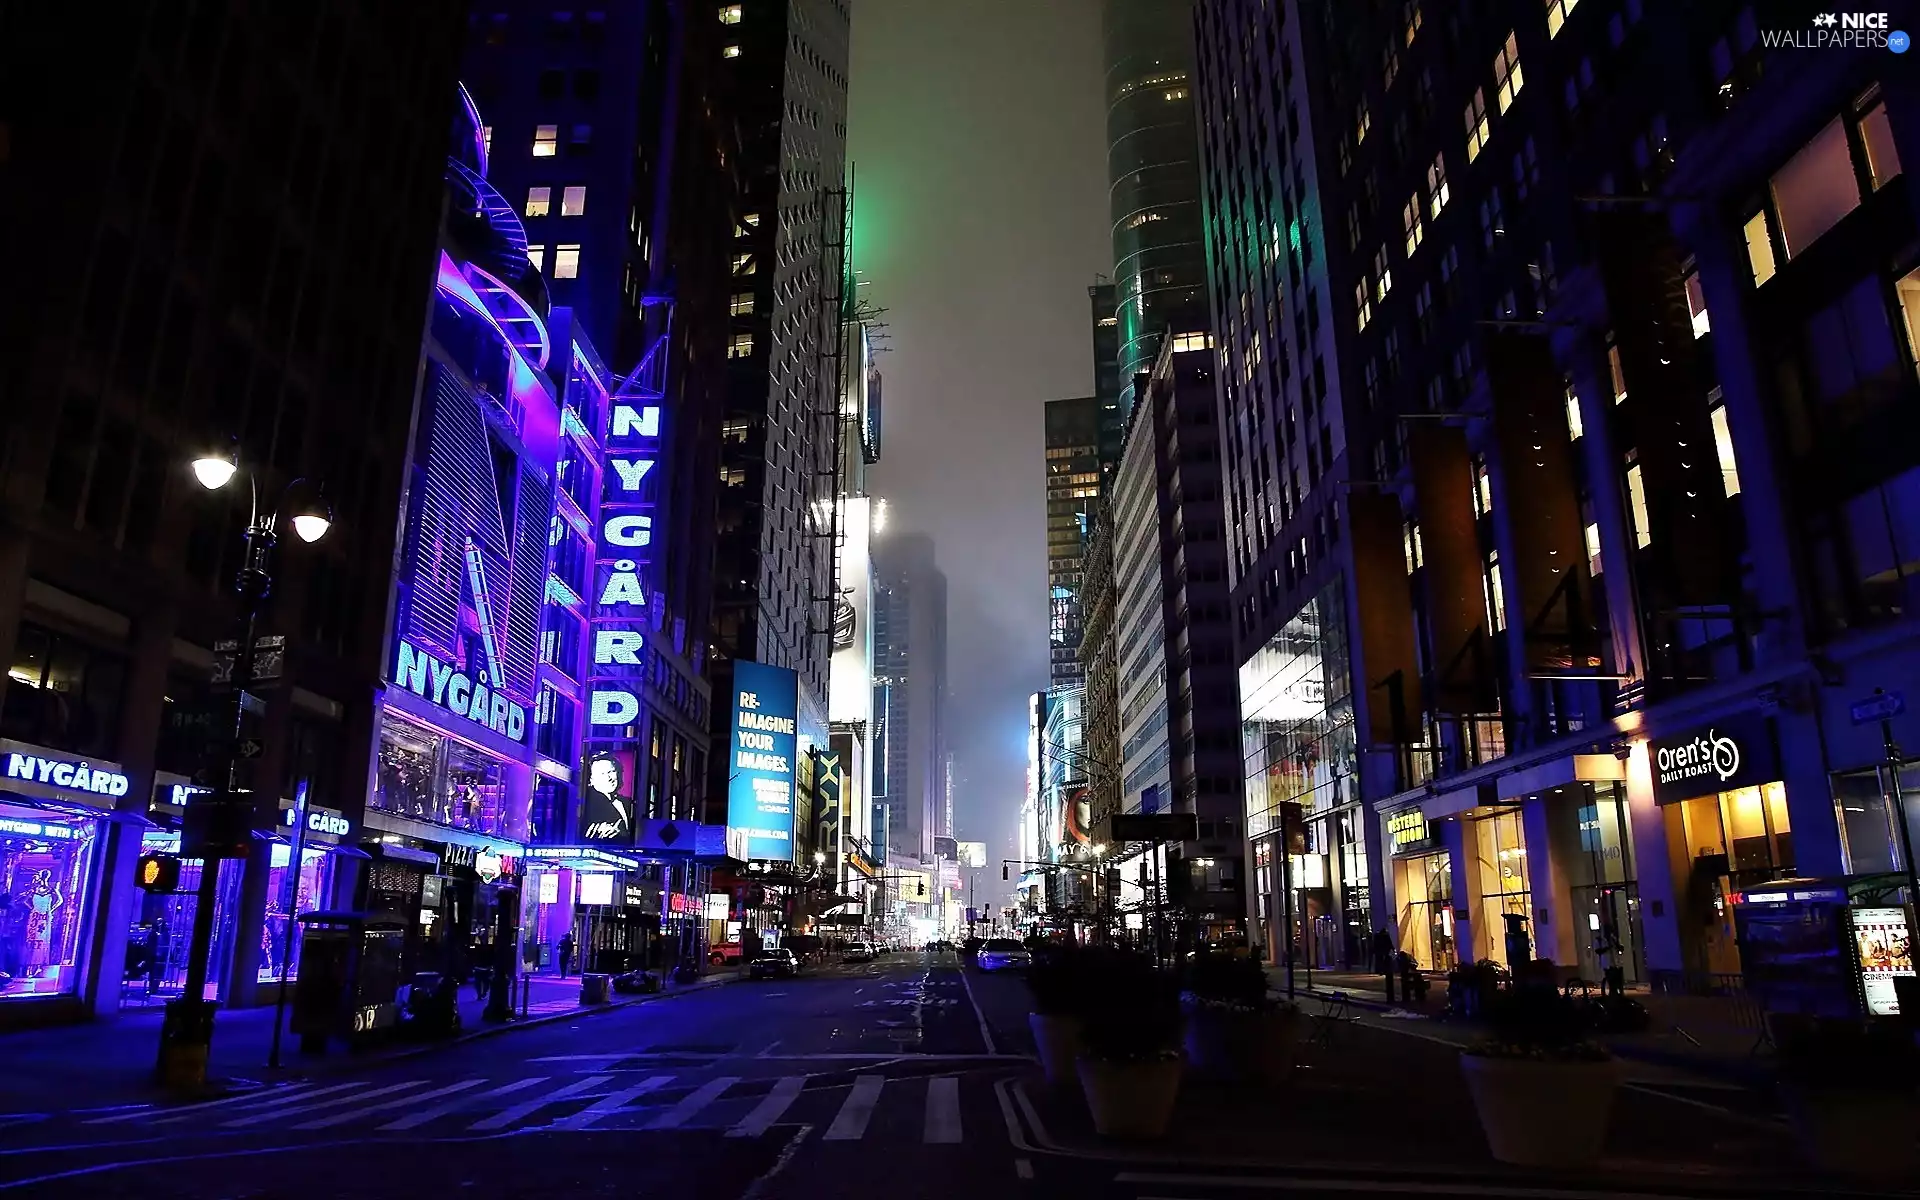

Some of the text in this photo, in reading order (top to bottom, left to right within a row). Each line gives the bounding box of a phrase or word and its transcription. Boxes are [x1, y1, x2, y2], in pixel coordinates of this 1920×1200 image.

[396, 640, 525, 741] NYGÅRD
[739, 691, 761, 709] RE-
[738, 711, 794, 735] IMAGINE
[737, 731, 774, 751] YOUR
[736, 751, 790, 773] IMAGES.
[1658, 736, 1711, 771] Oren's
[7, 752, 129, 797] NYGÅRD
[1660, 761, 1712, 784] DAILY ROAST
[444, 842, 475, 868] PIZZA
